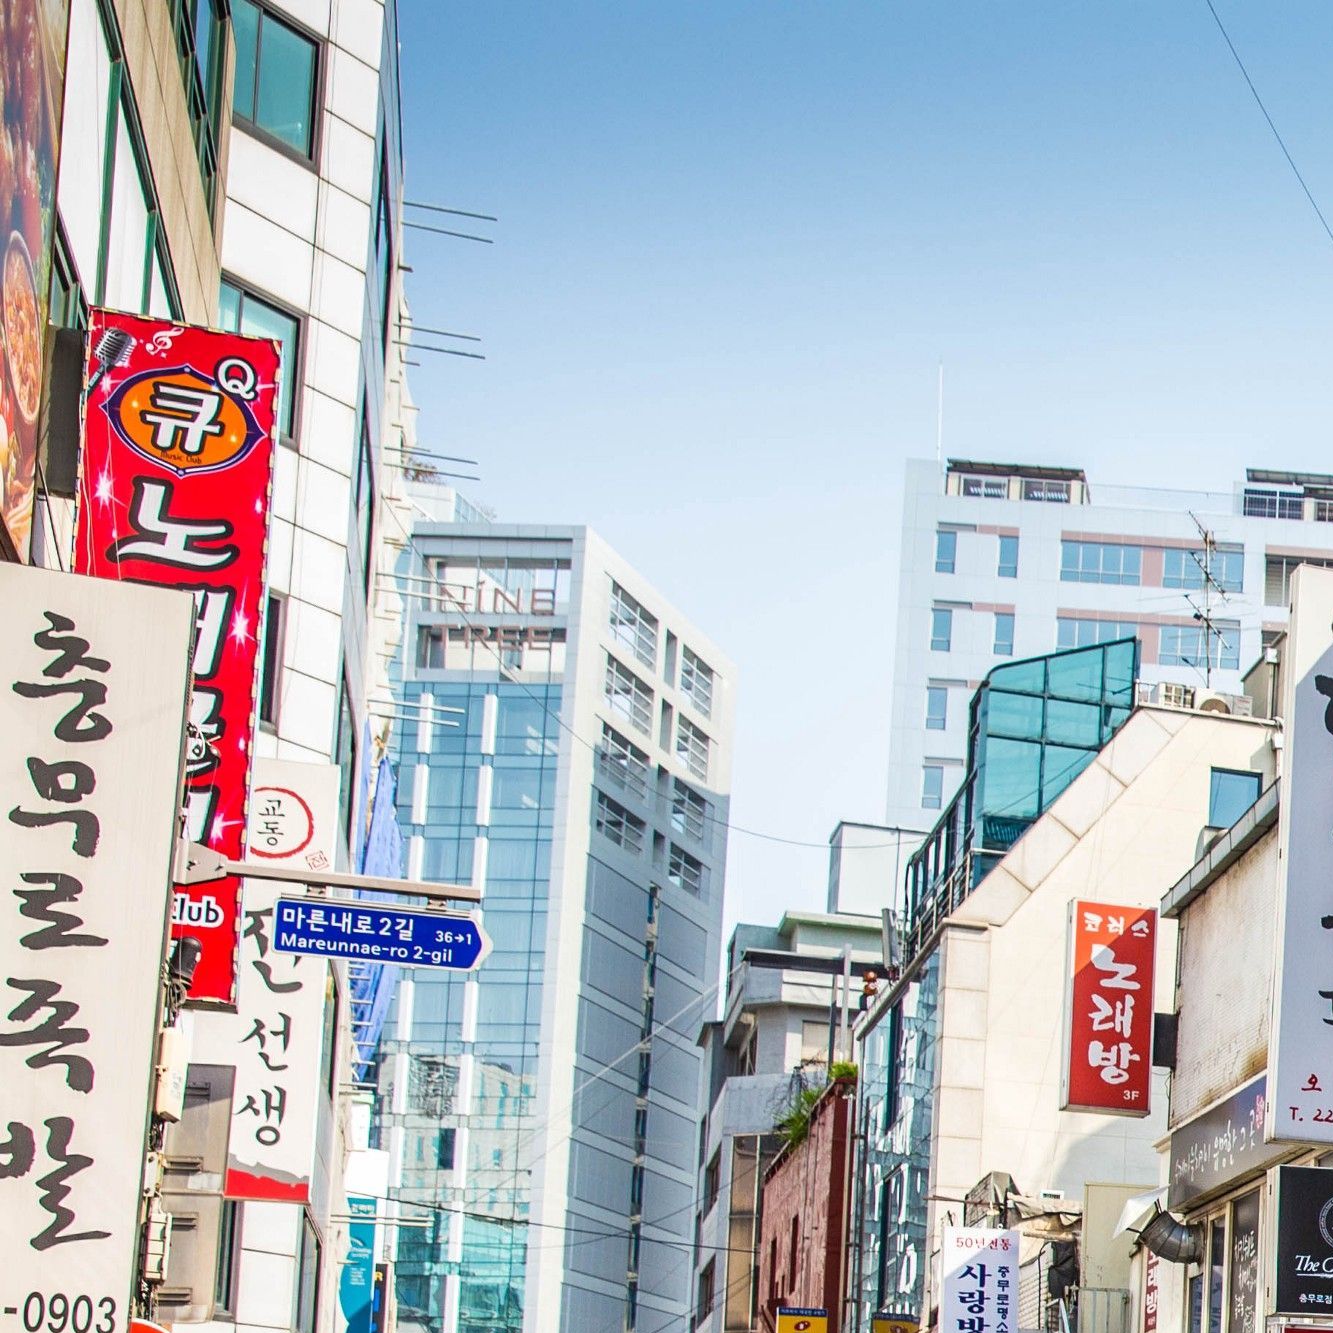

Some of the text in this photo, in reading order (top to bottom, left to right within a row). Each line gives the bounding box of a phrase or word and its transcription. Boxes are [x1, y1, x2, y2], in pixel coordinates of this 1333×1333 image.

[141, 382, 223, 453] 큐
[256, 798, 285, 846] 교동
[1081, 910, 1150, 940] 코러스
[280, 932, 454, 966] Mareunnae-ro 2-gil
[1087, 944, 1142, 1087] 노래방
[1122, 1089, 1140, 1102] 3F
[956, 1236, 1012, 1251] 50년 전통
[1294, 1253, 1320, 1274] The
[1299, 1292, 1333, 1307] 충무로점
